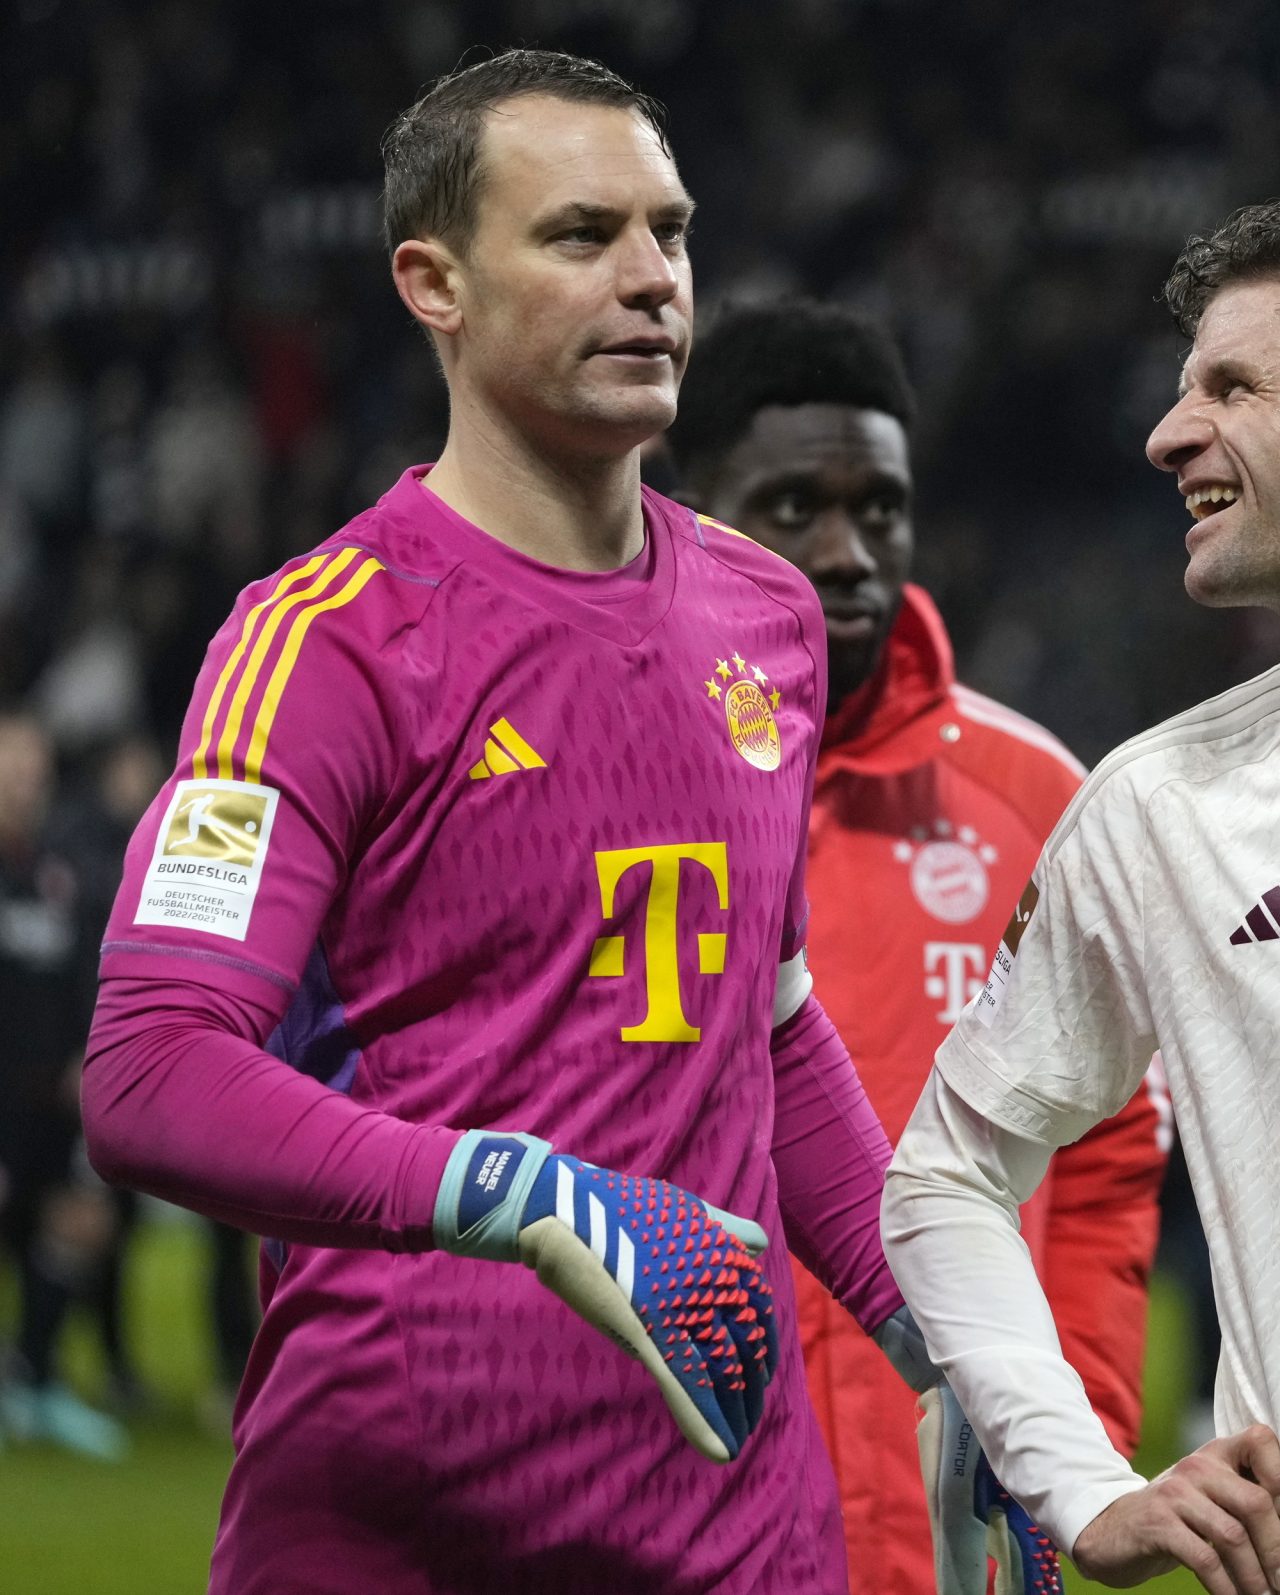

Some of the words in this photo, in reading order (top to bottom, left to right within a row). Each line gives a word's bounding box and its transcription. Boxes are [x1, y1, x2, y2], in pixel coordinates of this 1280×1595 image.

[736, 687, 772, 723] BAYERN
[157, 863, 248, 886] BUNDESLIGA
[147, 898, 240, 920] FUSSBALLMEISTER
[164, 889, 225, 908] DEUTSCHER
[163, 908, 217, 924] 2022/2023
[475, 1151, 500, 1186] NEUER
[484, 1150, 513, 1193] MANUEL
[953, 1418, 974, 1477] EDATOR
